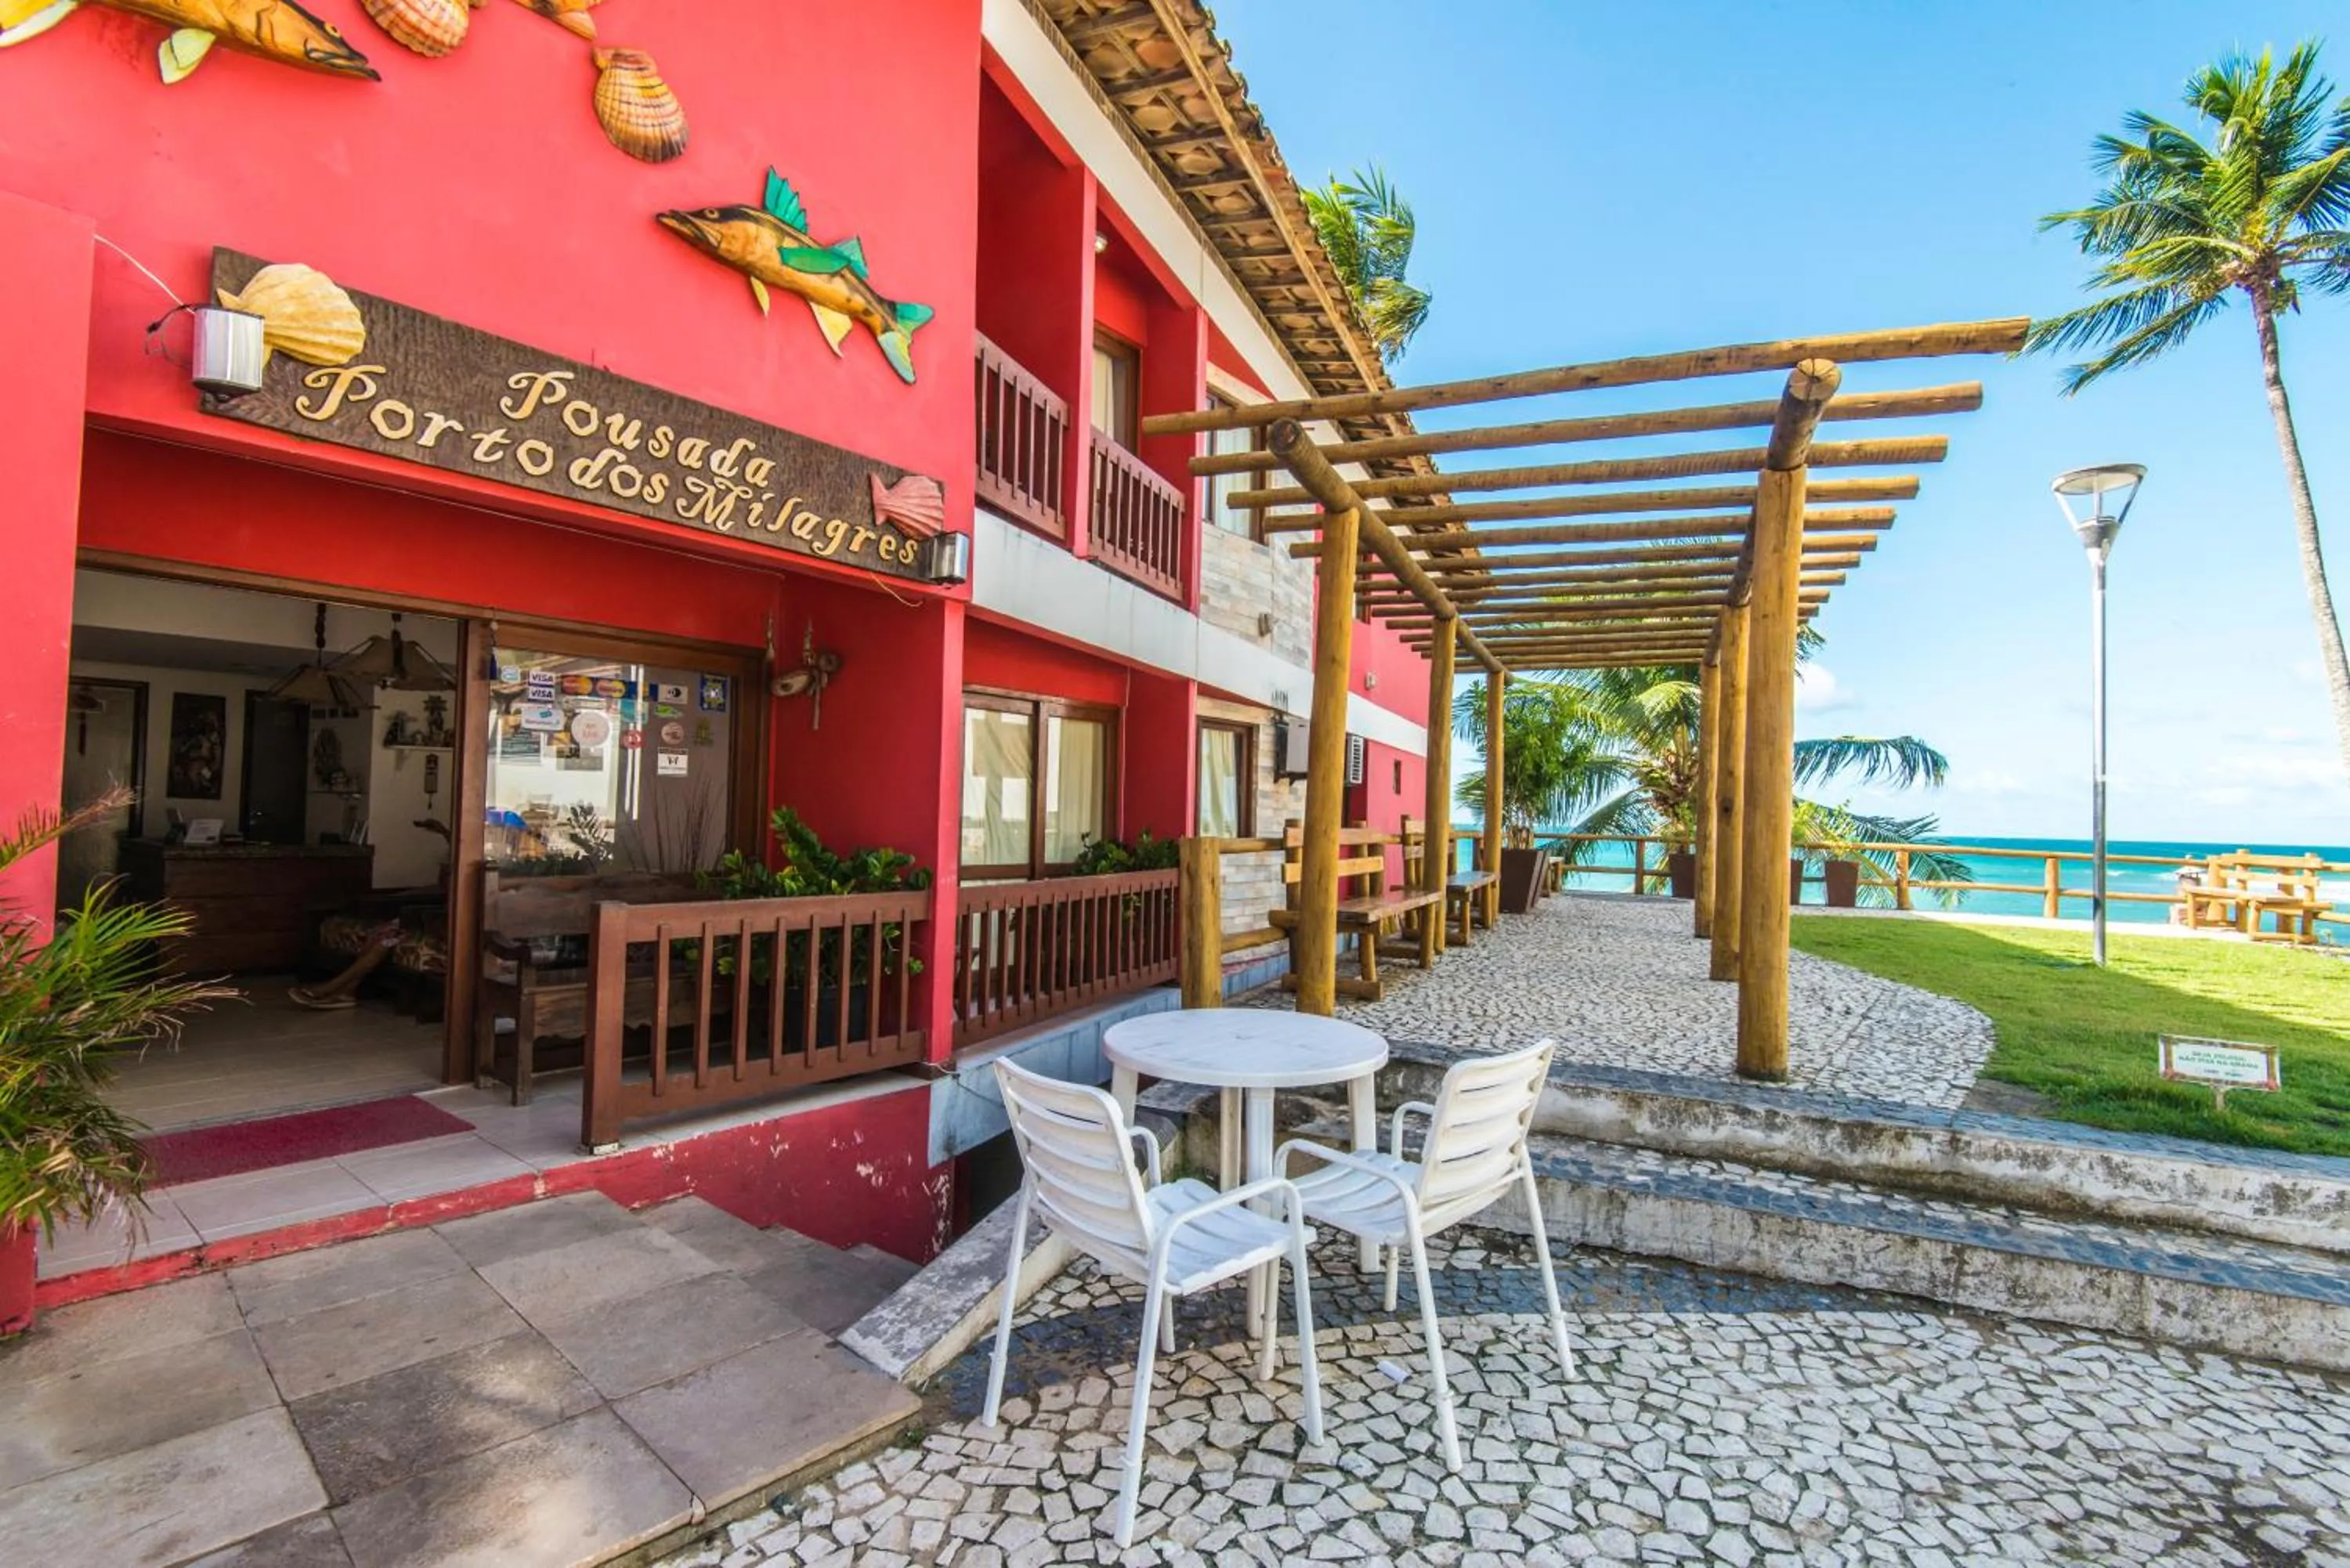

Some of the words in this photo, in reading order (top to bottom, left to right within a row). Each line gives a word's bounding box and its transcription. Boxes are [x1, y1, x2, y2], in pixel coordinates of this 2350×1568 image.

[499, 370, 776, 488] Pousada
[295, 364, 554, 475] Porto
[569, 447, 671, 504] dos
[676, 475, 918, 565] Milagres
[531, 690, 553, 699] VISA
[532, 674, 554, 682] VISA
